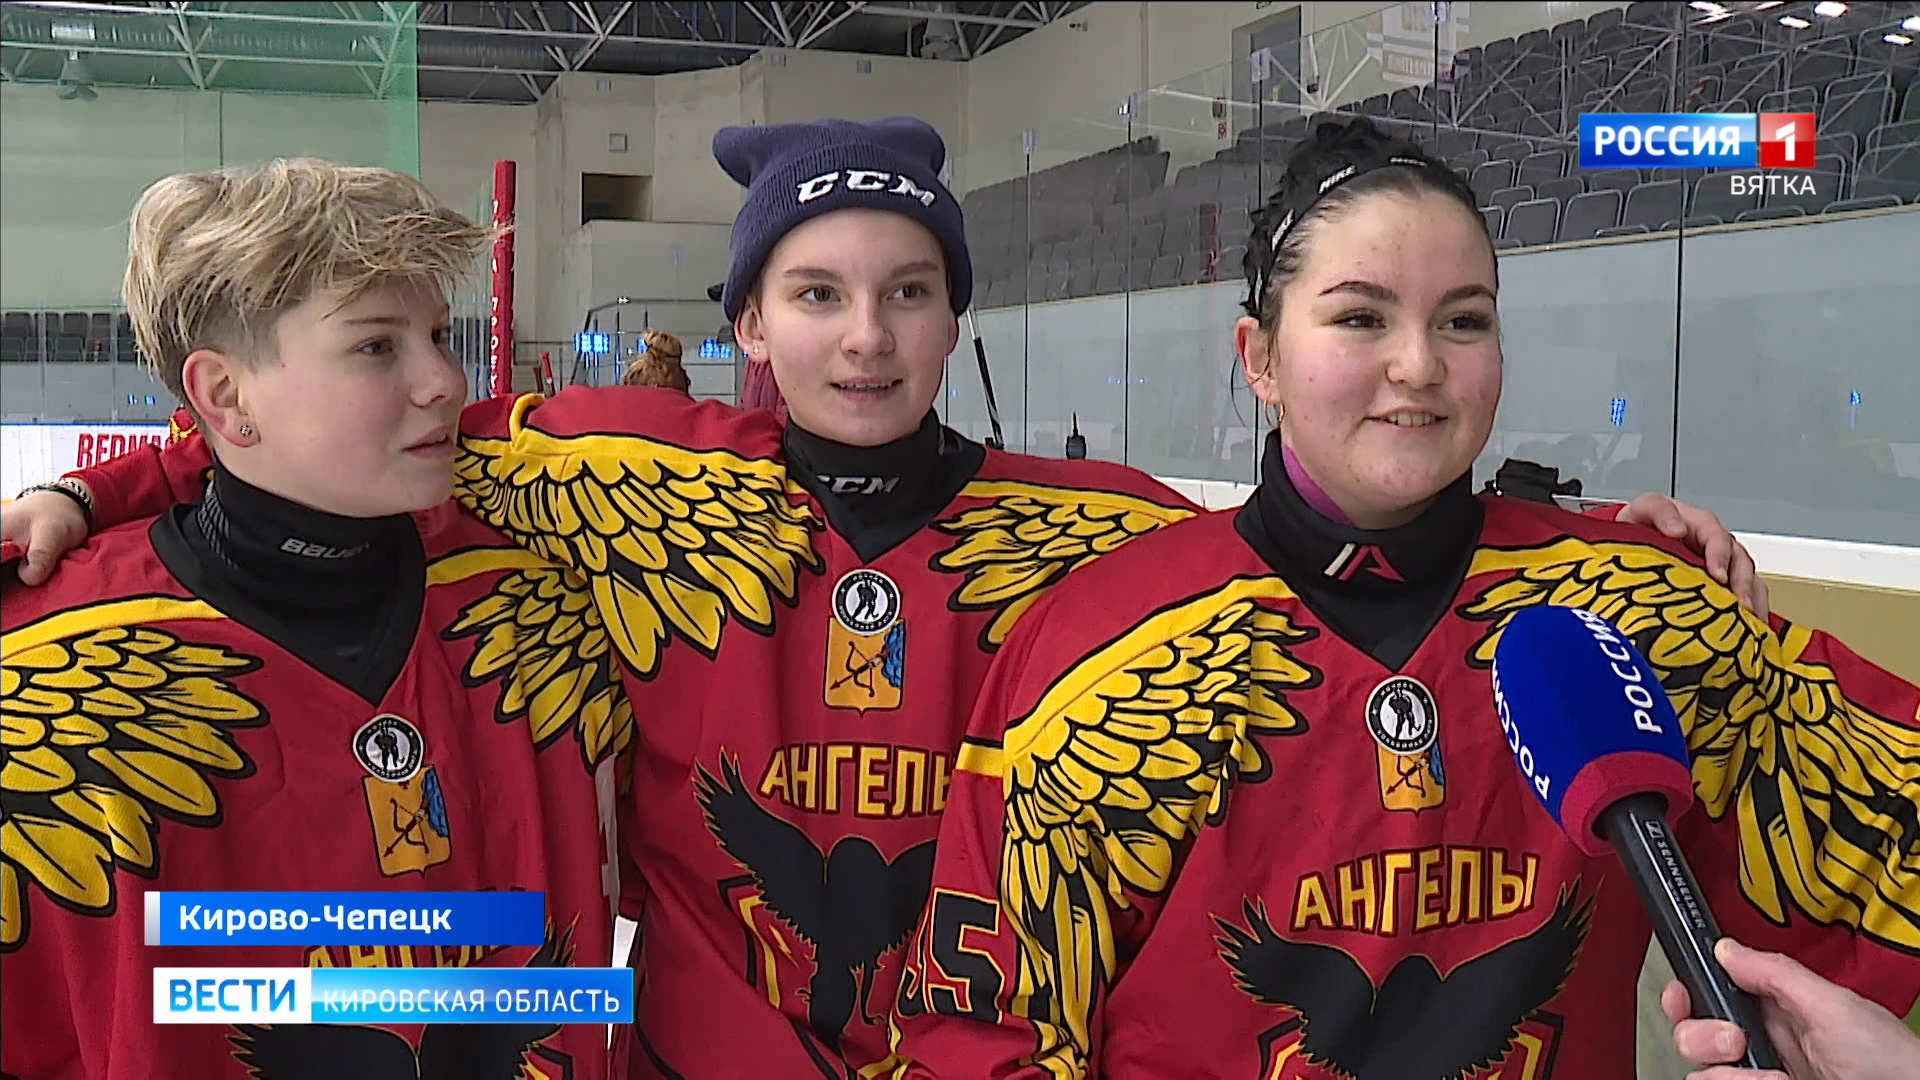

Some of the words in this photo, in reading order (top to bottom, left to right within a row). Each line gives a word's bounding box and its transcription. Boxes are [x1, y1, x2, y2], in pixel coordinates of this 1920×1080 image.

[797, 169, 935, 207] CCM
[817, 475, 900, 495] CM
[1570, 608, 1663, 734] РОССИЯ
[1291, 845, 1540, 936] АНГЕЛЫ
